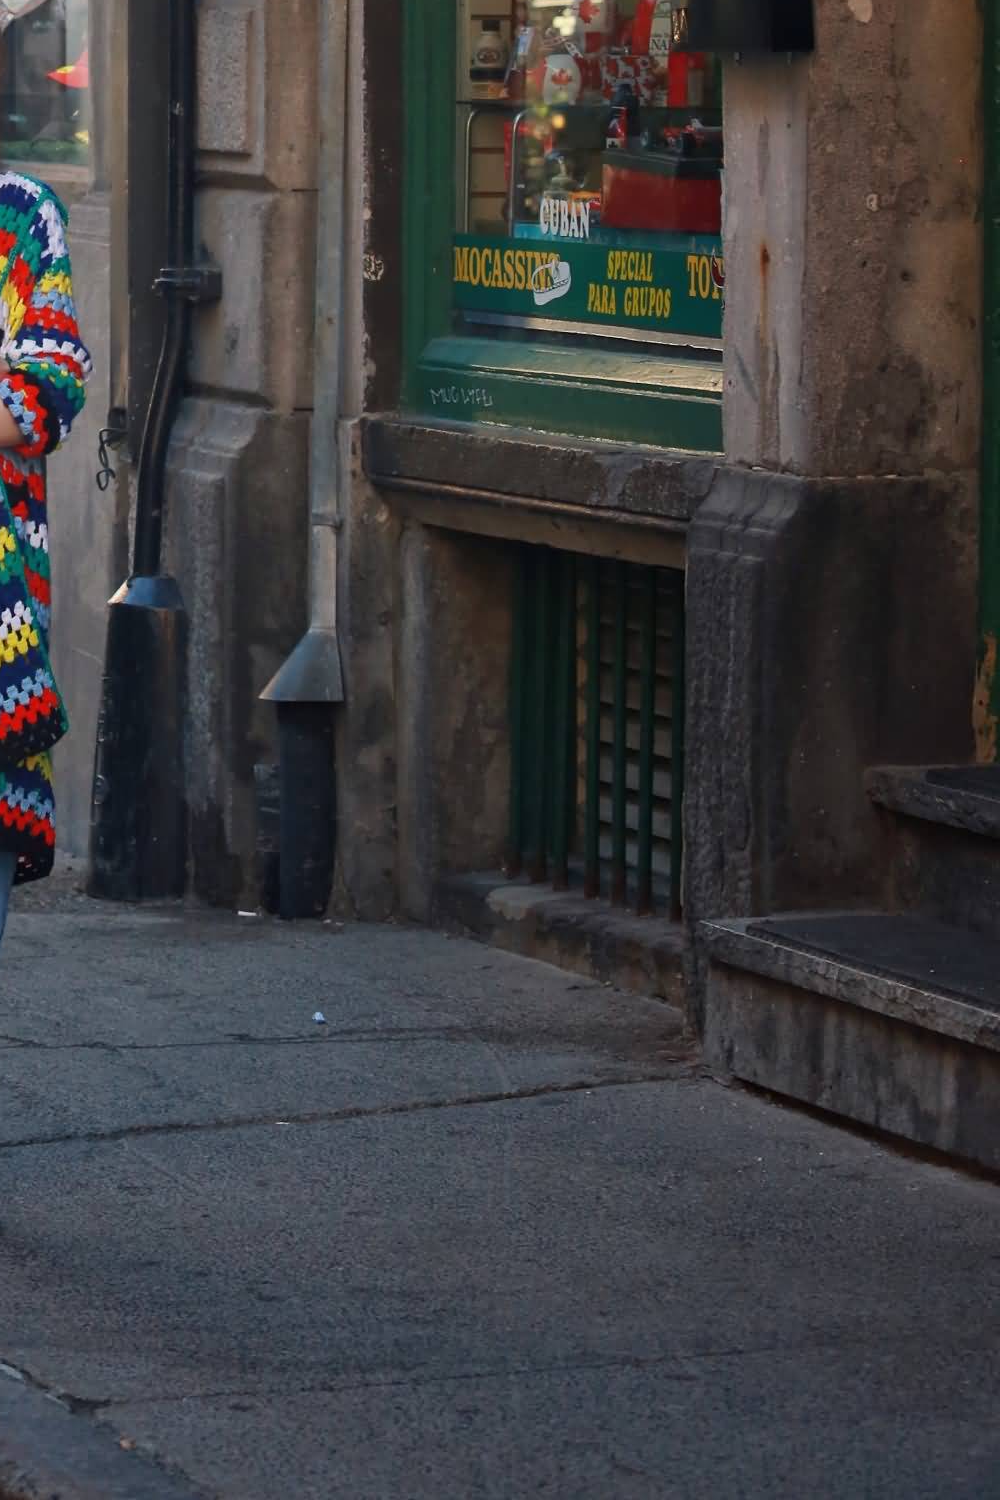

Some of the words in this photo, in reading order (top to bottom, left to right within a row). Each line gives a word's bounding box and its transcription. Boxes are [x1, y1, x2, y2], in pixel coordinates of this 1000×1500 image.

[540, 197, 590, 238] CUBAN
[607, 250, 653, 282] SPECIAL
[588, 283, 616, 315] PARA
[624, 286, 671, 318] GRUPOS
